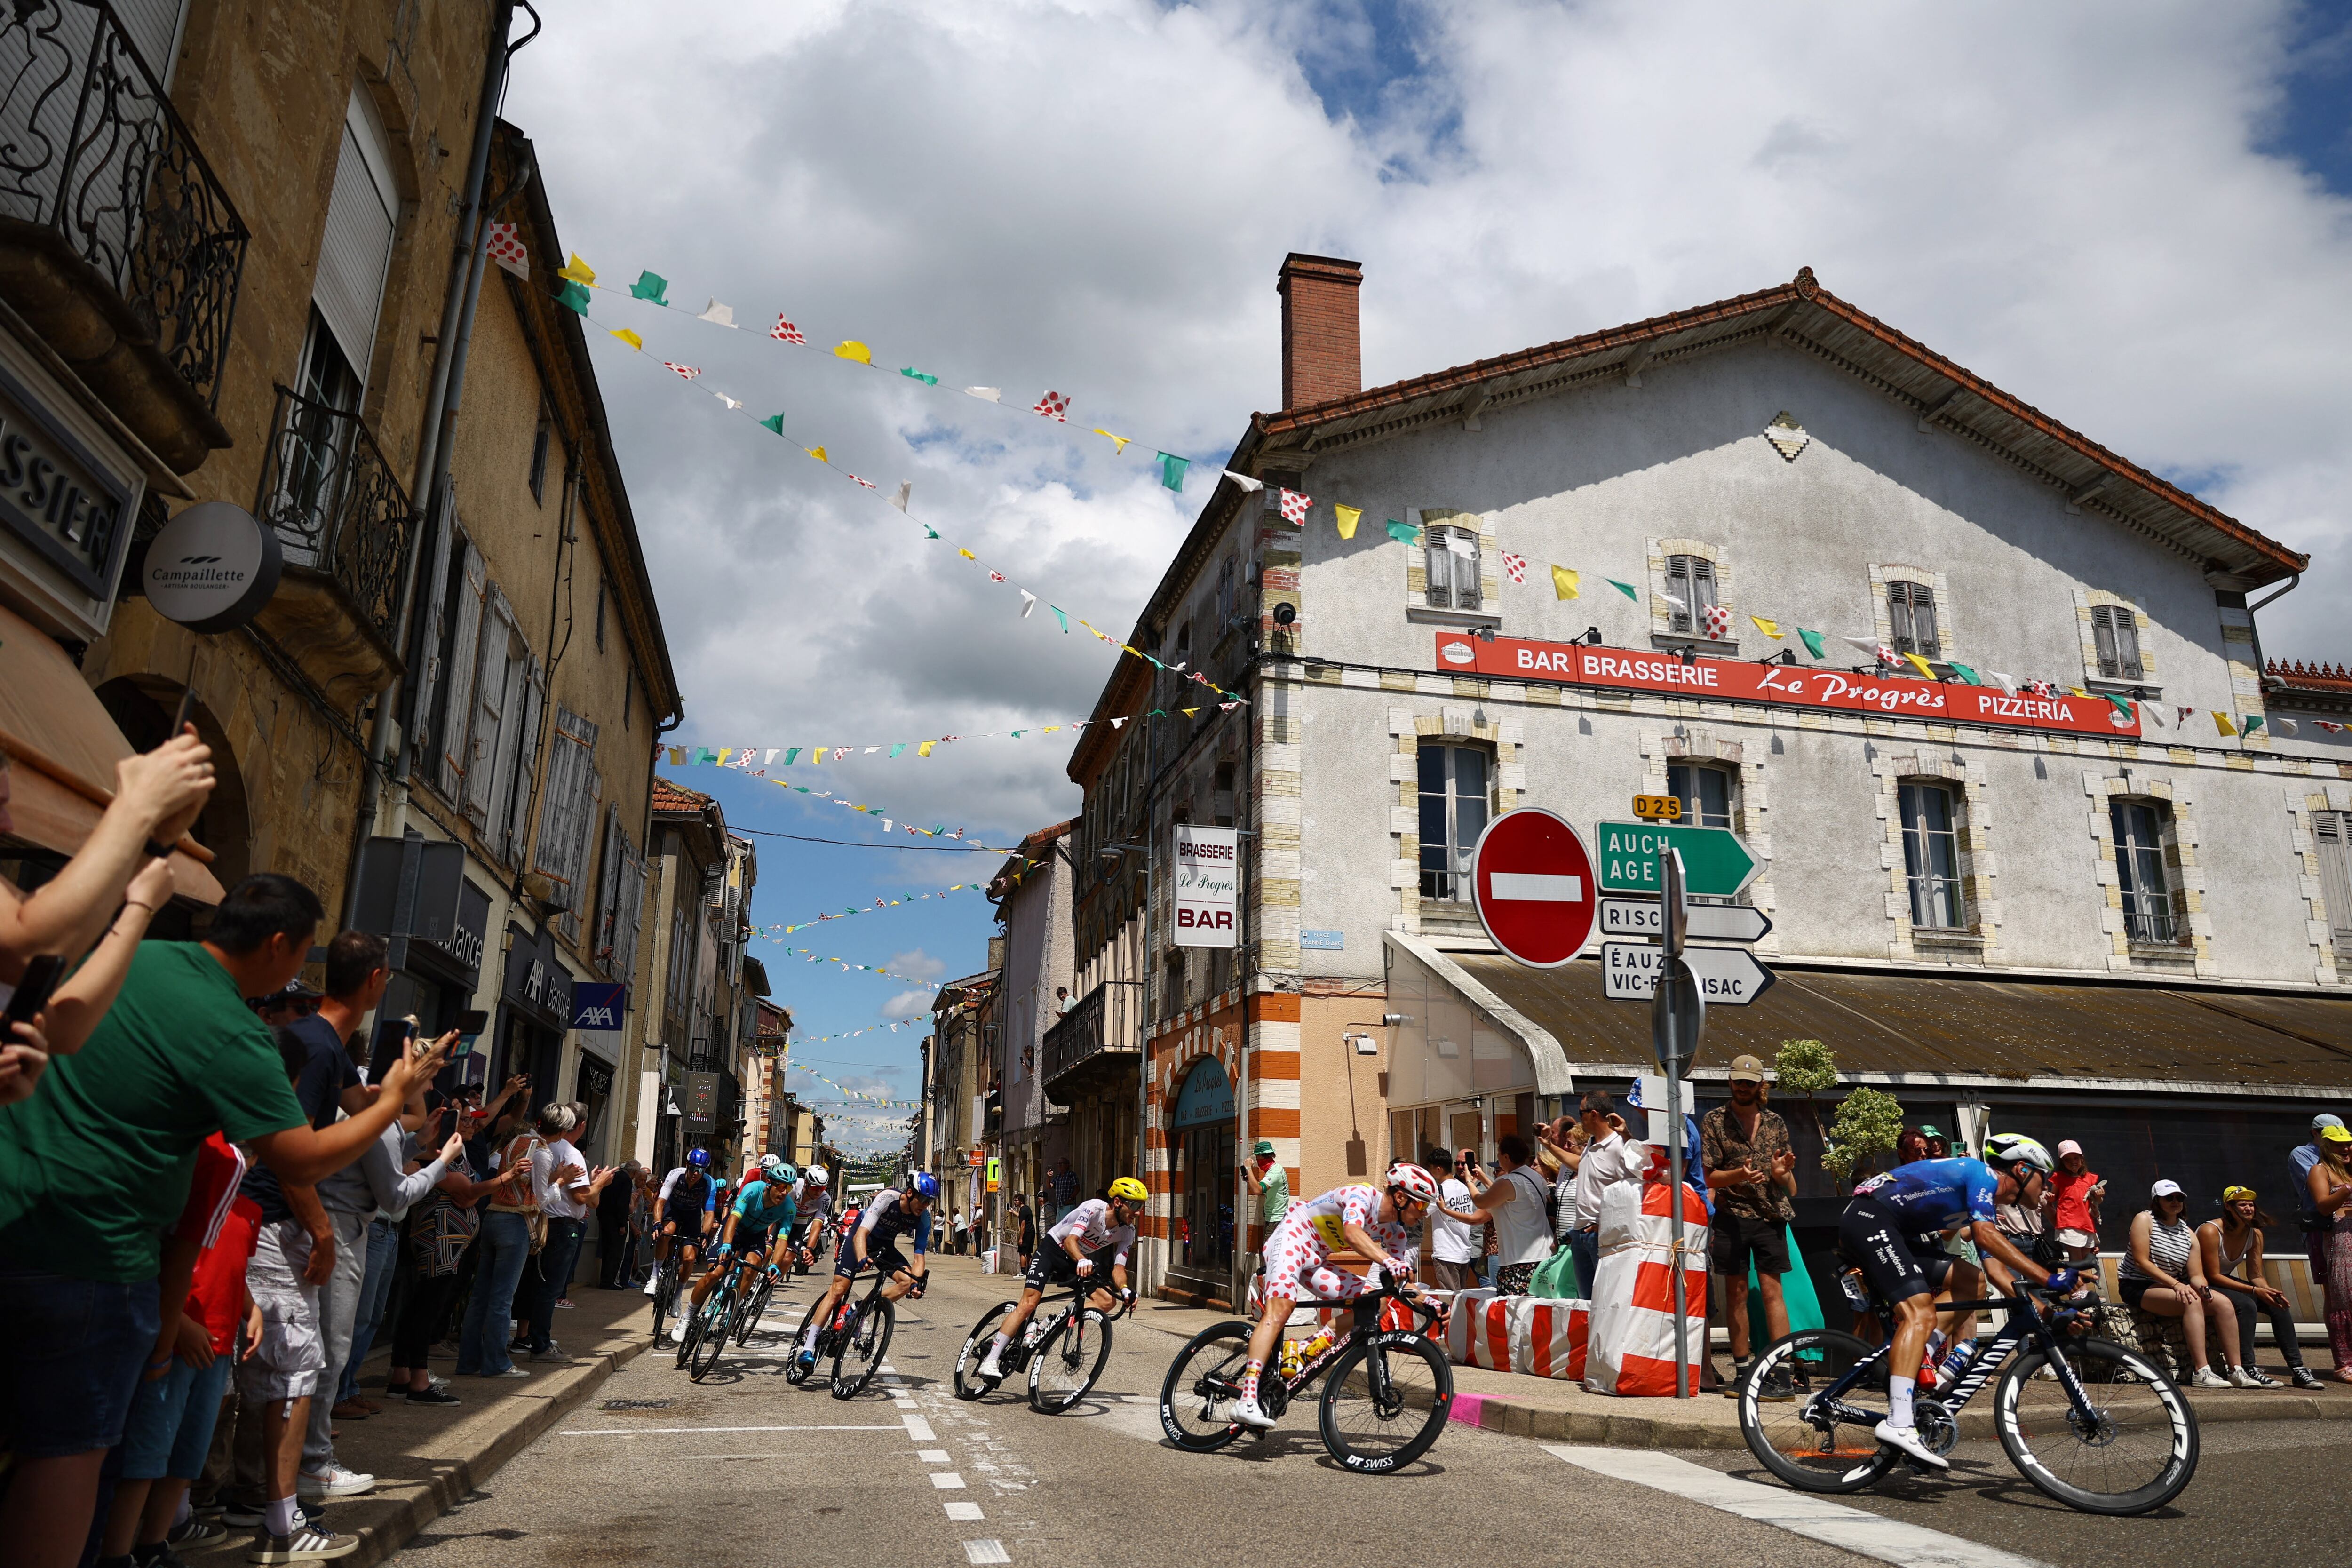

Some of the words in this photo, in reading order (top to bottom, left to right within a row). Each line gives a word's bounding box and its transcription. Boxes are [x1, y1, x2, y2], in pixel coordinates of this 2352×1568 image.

[0, 420, 110, 574] SSIER
[152, 568, 244, 583] Campaillette
[1518, 649, 1569, 672] BAR
[1584, 655, 1718, 687] BRASSERIE
[1756, 669, 1804, 693] Le
[1812, 674, 1945, 709] Progrès
[1979, 695, 2074, 722] PIZZERIA
[1637, 798, 1647, 813] D
[1654, 799, 1677, 815] 25
[1179, 842, 1233, 860] BRASSERIE
[1608, 833, 1669, 854] AUCH
[1610, 860, 1654, 881] AGE
[1177, 872, 1192, 888] Le
[1198, 874, 1233, 896] Progrès
[1178, 908, 1232, 930] BAR
[1610, 909, 1660, 926] RISC
[434, 923, 483, 969] rance
[1612, 948, 1664, 969] ÉAUZ
[524, 959, 544, 1004] AXA
[548, 976, 571, 1024] Banque
[574, 1007, 614, 1026] AXA
[1194, 1072, 1202, 1093] Le
[1202, 1071, 1223, 1098] Progrès
[1195, 1105, 1212, 1119] BRASSERIE
[1903, 1189, 1936, 1201] Telefónica
[1976, 1187, 1986, 1202] vivo
[1325, 1220, 1344, 1246] Uno
[1270, 1237, 1283, 1274] REITAN
[1875, 1247, 1888, 1265] Tech
[1884, 1244, 1906, 1276] Telefónica
[1027, 1258, 1039, 1275] UAE
[1843, 1277, 1859, 1297] 155
[1029, 1308, 1067, 1349] COLNAGO
[1378, 1332, 1401, 1344] SWISS
[1401, 1334, 1419, 1345] DT
[1943, 1338, 2018, 1410] CANYON
[2066, 1367, 2093, 1410] CANYON
[1162, 1404, 1171, 1418] DT
[1829, 1401, 1867, 1417] CANYON
[1165, 1418, 1183, 1441] SWISS
[1346, 1454, 1364, 1465] DT
[1364, 1456, 1394, 1469] SWISS
[2165, 1461, 2183, 1486] ZIPP
